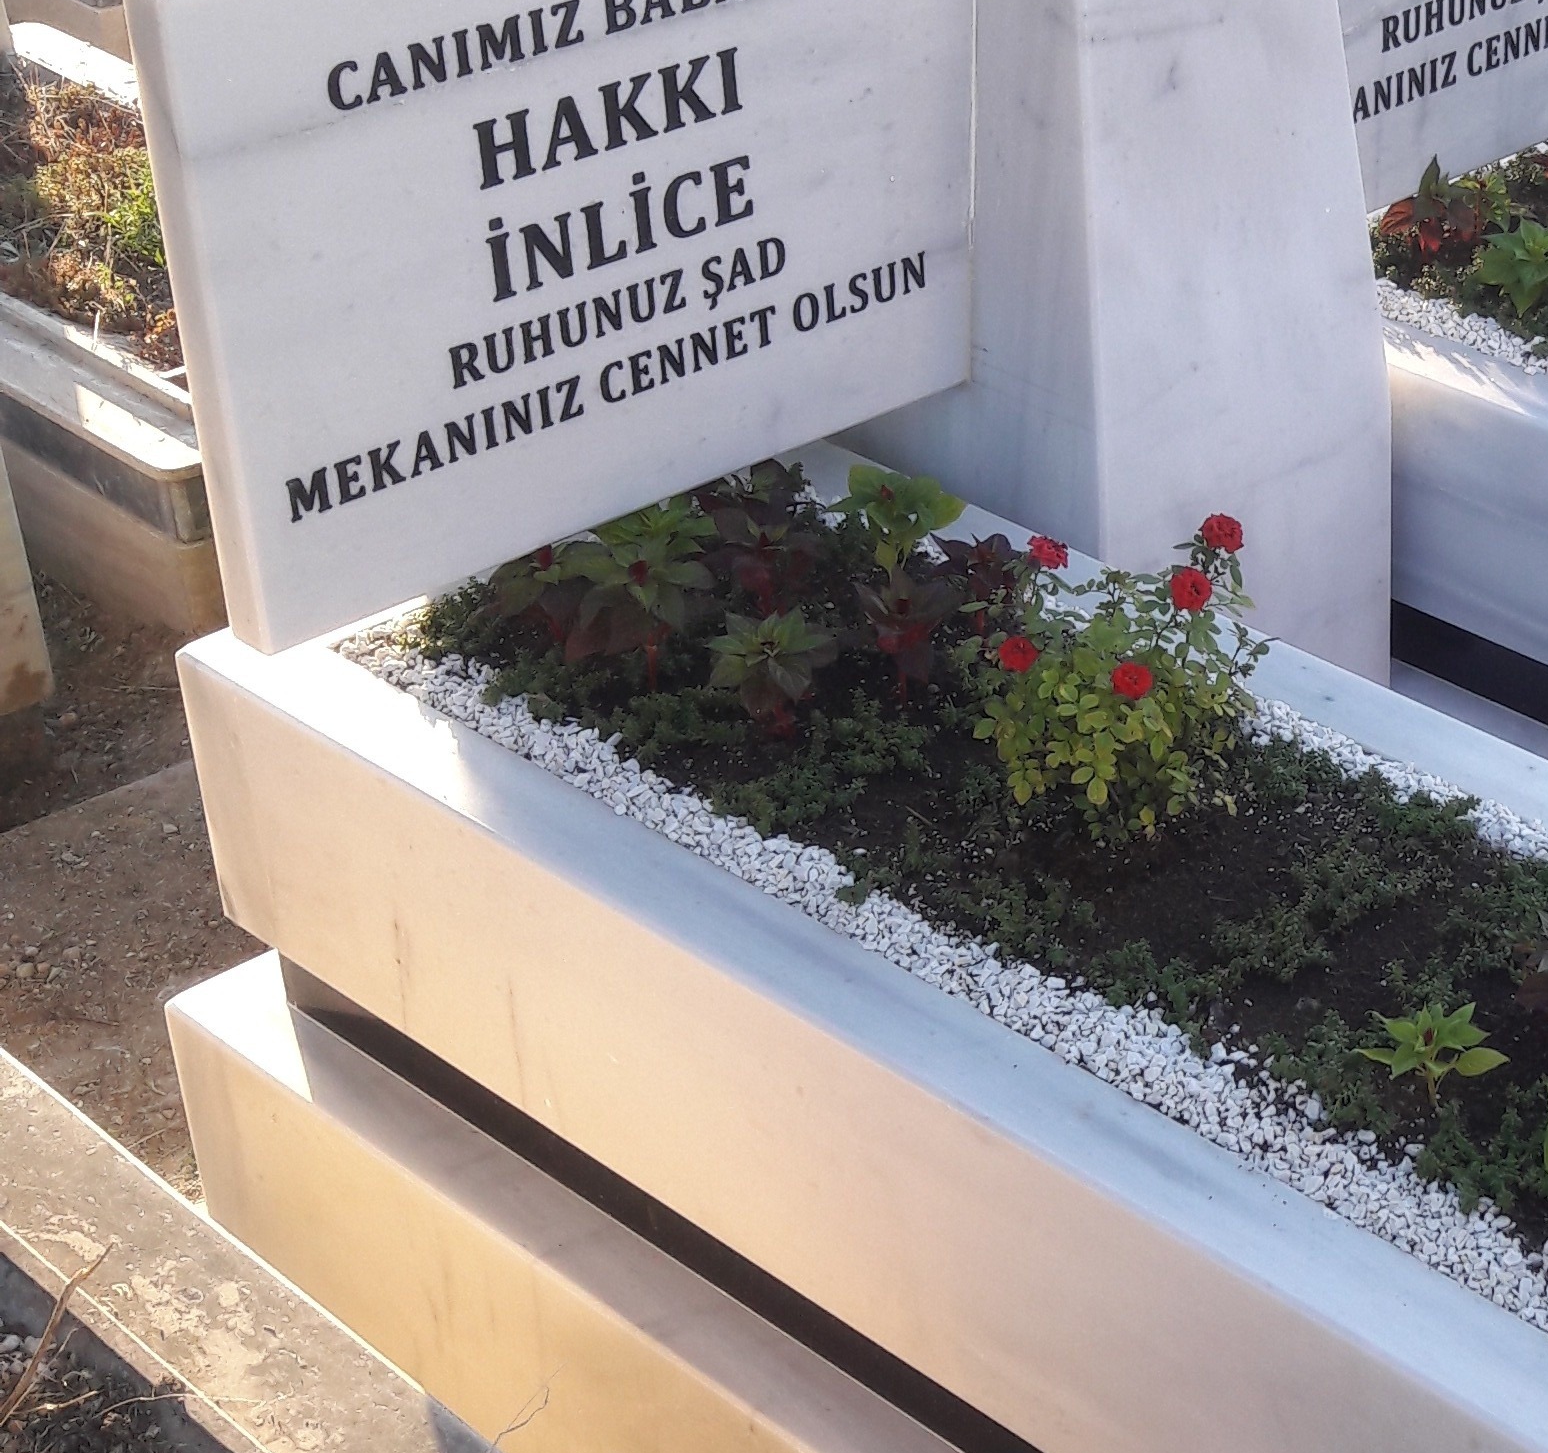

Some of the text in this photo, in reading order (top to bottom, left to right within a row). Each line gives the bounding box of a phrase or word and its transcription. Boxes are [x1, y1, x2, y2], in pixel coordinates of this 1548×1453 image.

[472, 46, 744, 191] HAKKI
[484, 154, 754, 303] İNLİCE
[285, 250, 926, 524] MEKANINIZ CENNET OLSUN
[448, 237, 786, 390] RUHUNUZ ŞAD
